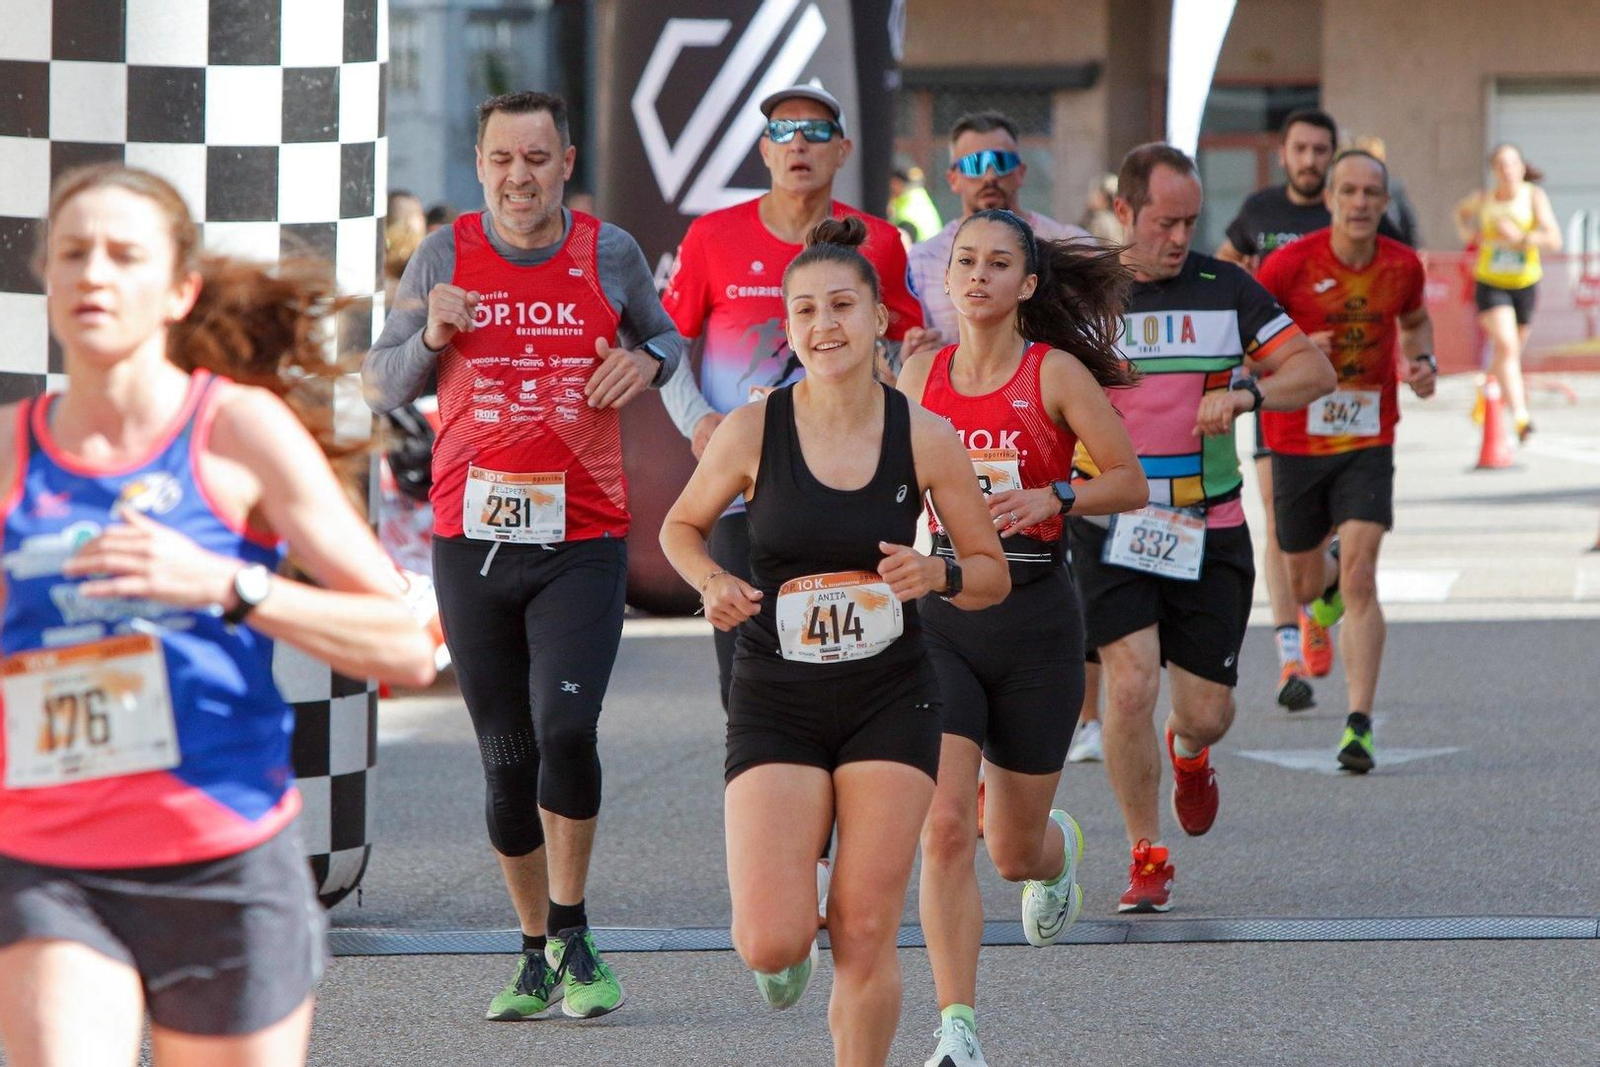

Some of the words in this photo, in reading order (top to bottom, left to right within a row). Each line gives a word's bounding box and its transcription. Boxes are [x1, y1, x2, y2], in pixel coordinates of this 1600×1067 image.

[1125, 315, 1196, 346] LOIA
[491, 485, 527, 495] FELIPE75
[487, 495, 531, 528] 231
[1128, 526, 1179, 562] 332
[818, 591, 847, 602] ANITA
[807, 602, 865, 645] 414
